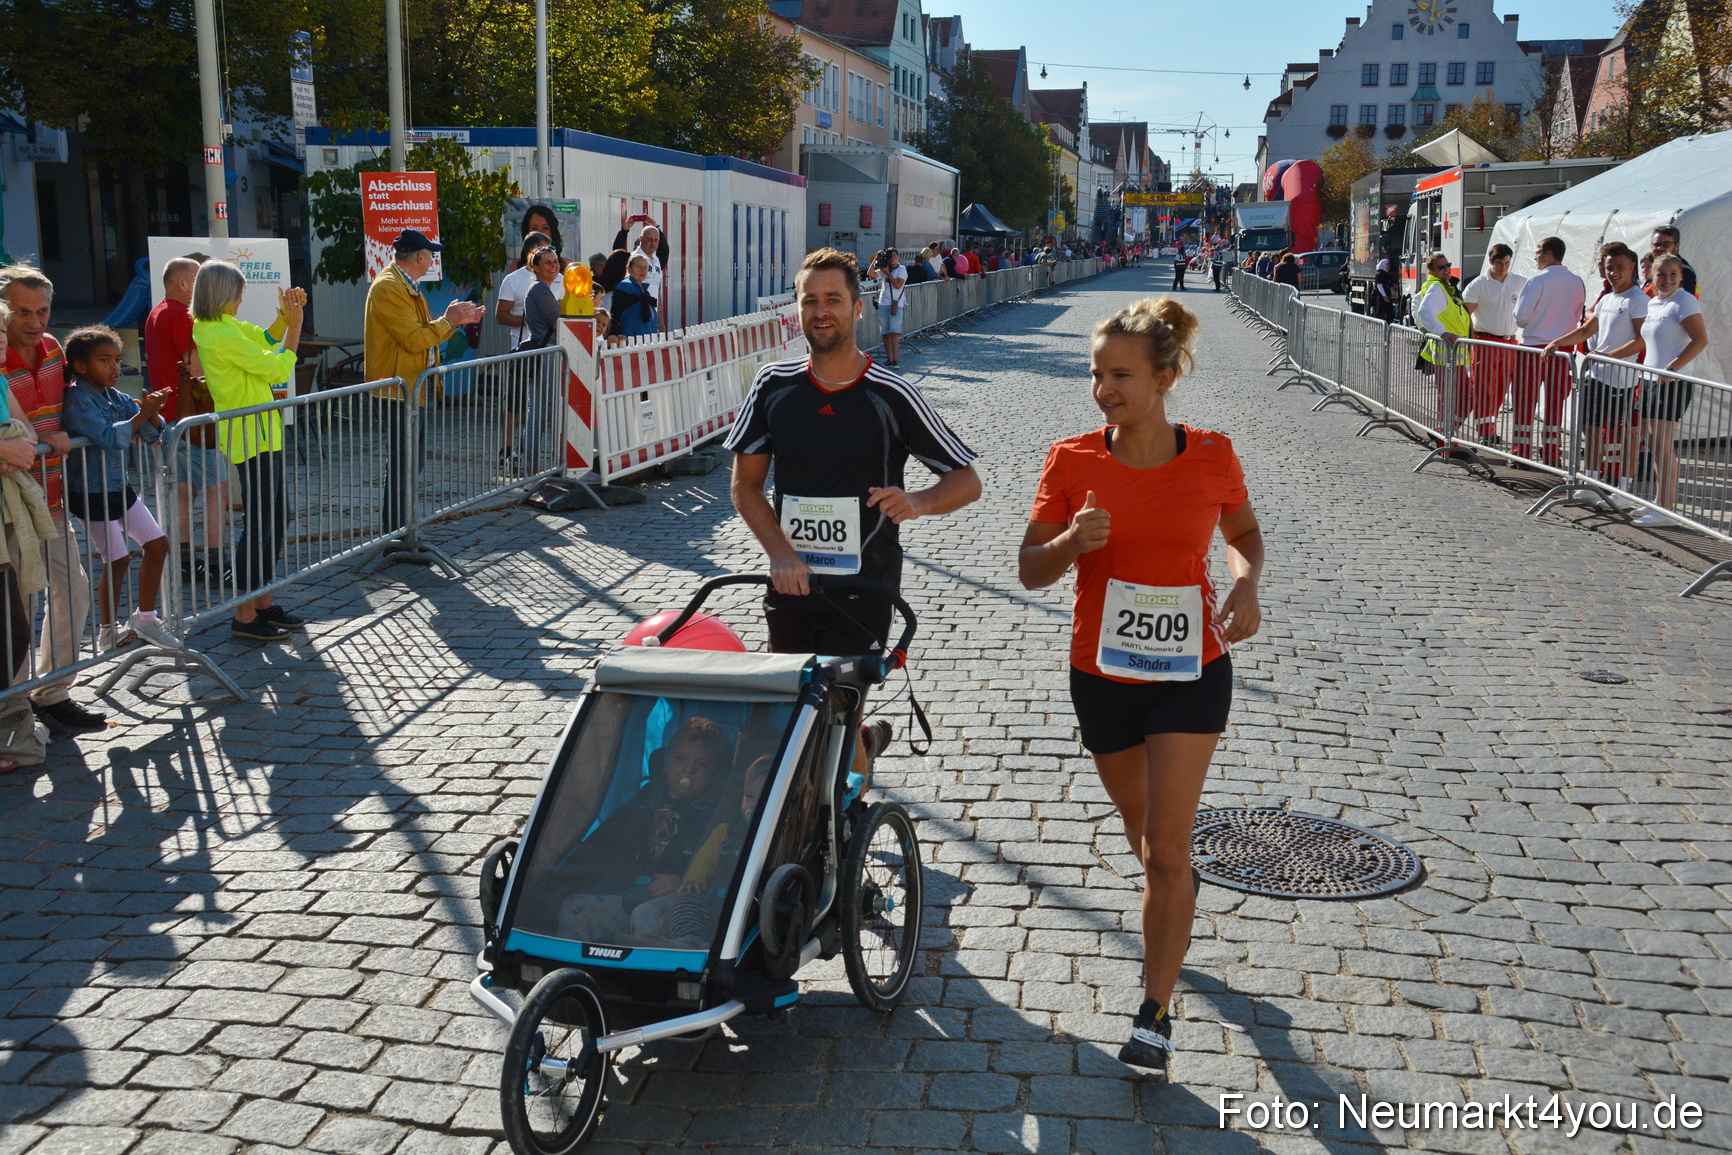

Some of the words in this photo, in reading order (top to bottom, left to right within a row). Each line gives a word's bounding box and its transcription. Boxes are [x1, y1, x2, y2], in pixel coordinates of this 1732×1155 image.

[241, 176, 248, 192] 3
[368, 180, 432, 192] Abschluss
[370, 200, 433, 210] Ausschluss!
[150, 213, 180, 222] STREB
[240, 262, 272, 270] FREIE
[242, 270, 281, 280] ÄHLER
[799, 504, 834, 513] BOCK
[790, 518, 847, 542] 2508
[806, 554, 836, 566] Marco
[1134, 593, 1179, 606] BOCK
[1116, 609, 1189, 642] 2509
[1121, 641, 1142, 650] PARTL
[1128, 655, 1172, 670] Sandra
[588, 946, 622, 958] THULE
